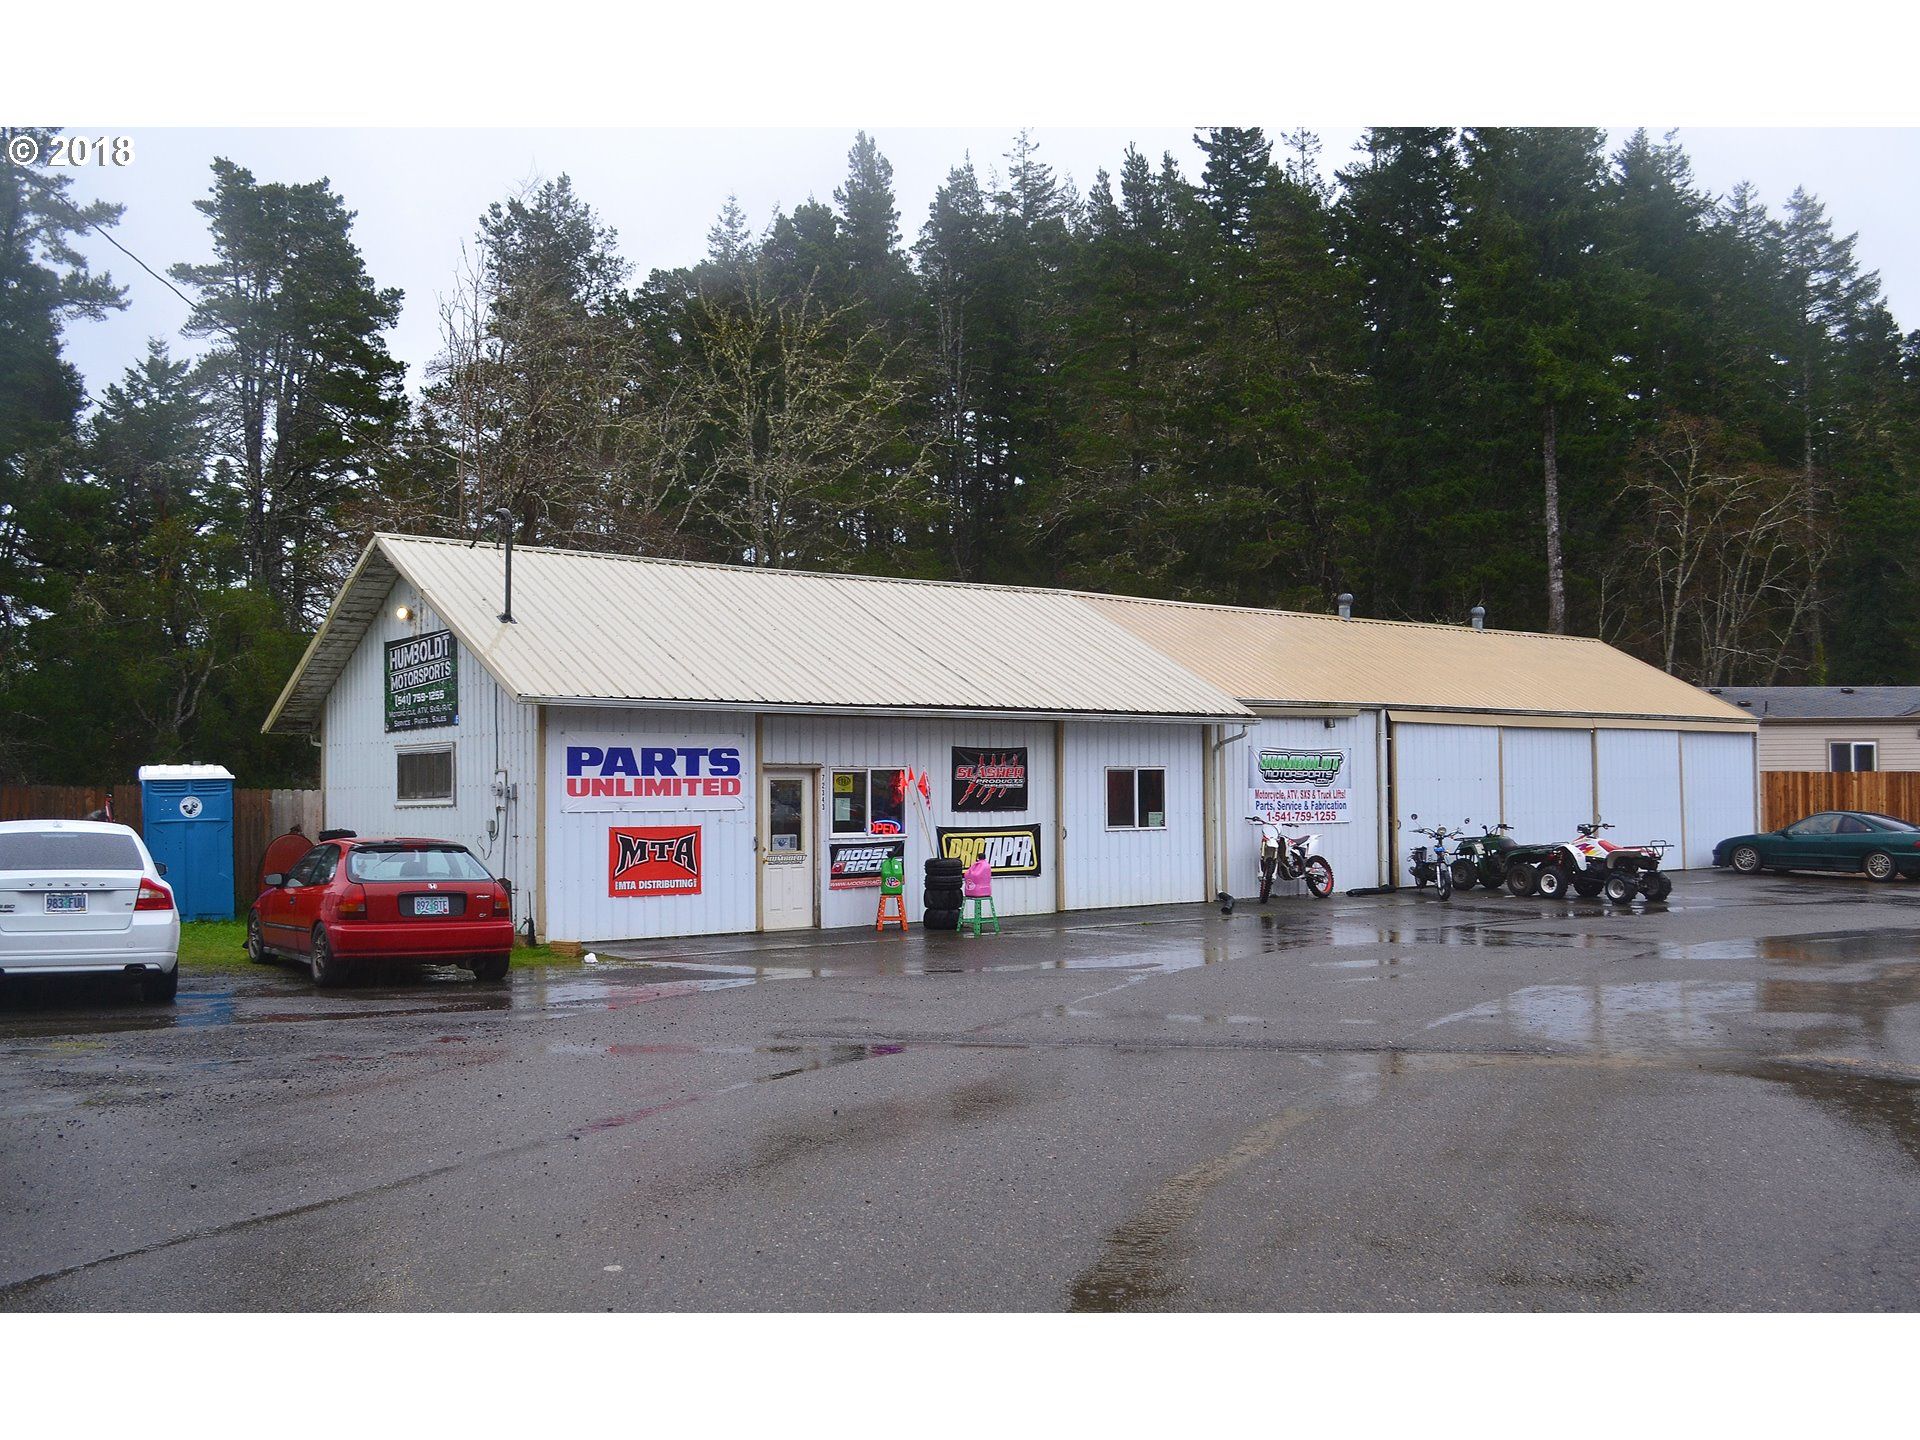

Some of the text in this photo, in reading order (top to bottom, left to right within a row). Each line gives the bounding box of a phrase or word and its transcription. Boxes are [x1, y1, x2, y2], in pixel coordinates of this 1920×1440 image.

[390, 634, 450, 671] HUMBOLDT
[391, 661, 451, 691] MOTORSPORTS
[413, 690, 445, 703] 759-1255
[567, 746, 741, 777] PARTS
[1260, 754, 1341, 770] HUMBOLDT
[956, 766, 1025, 779] SLASHER
[1265, 770, 1334, 779] MOTORSPORTS
[567, 778, 741, 797] UNLIMITED
[1255, 789, 1286, 801] Motorcycle,
[1317, 789, 1332, 800] Truck
[1255, 800, 1347, 811] Parts, Service & Fabrication
[1266, 811, 1337, 822] 1-541-759-1255
[871, 822, 898, 834] OPEN
[615, 833, 698, 877] MTA
[836, 848, 894, 861] MOOSE
[618, 879, 693, 890] MTA DISTRIBUTING
[46, 898, 64, 909] 983
[416, 900, 430, 910] 892
